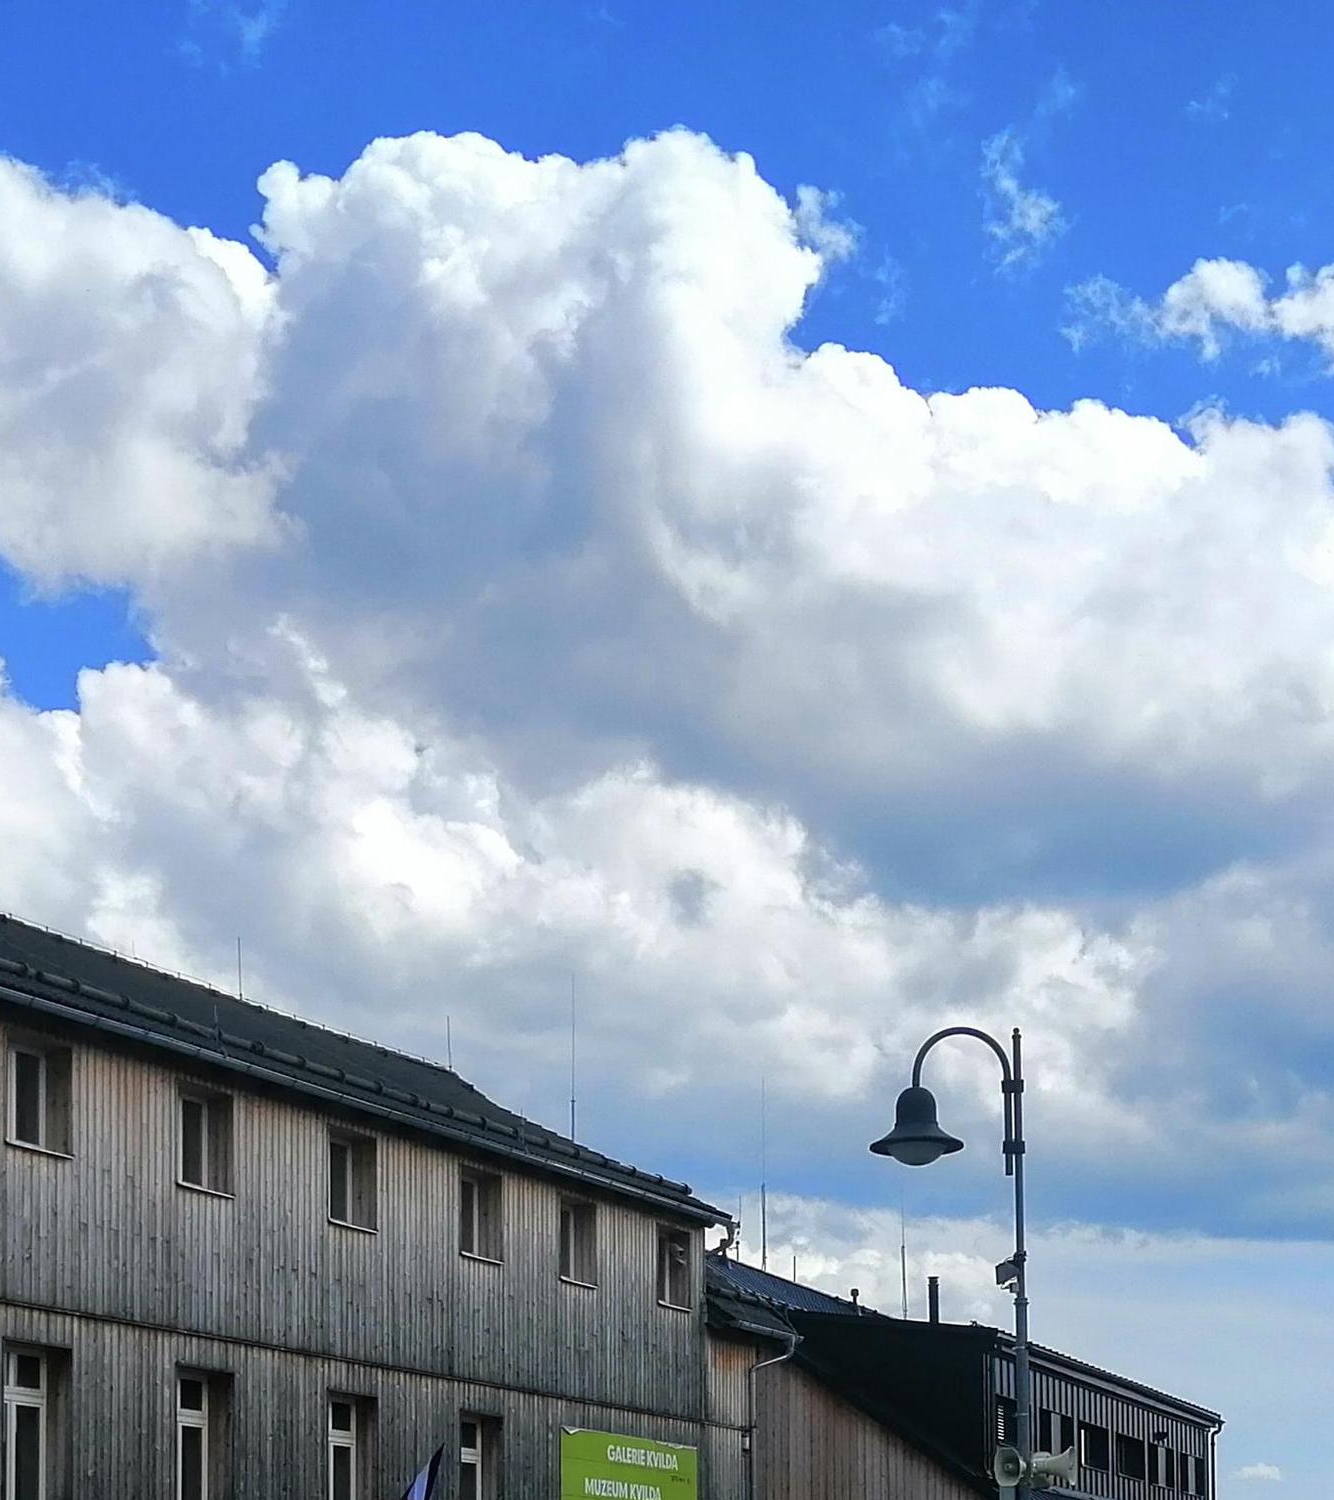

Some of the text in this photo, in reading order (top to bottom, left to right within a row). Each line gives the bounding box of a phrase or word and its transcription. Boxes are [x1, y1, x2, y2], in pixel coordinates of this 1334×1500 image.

[607, 1444, 679, 1471] GALERIE KVILDA
[584, 1477, 628, 1499] MUZEUM
